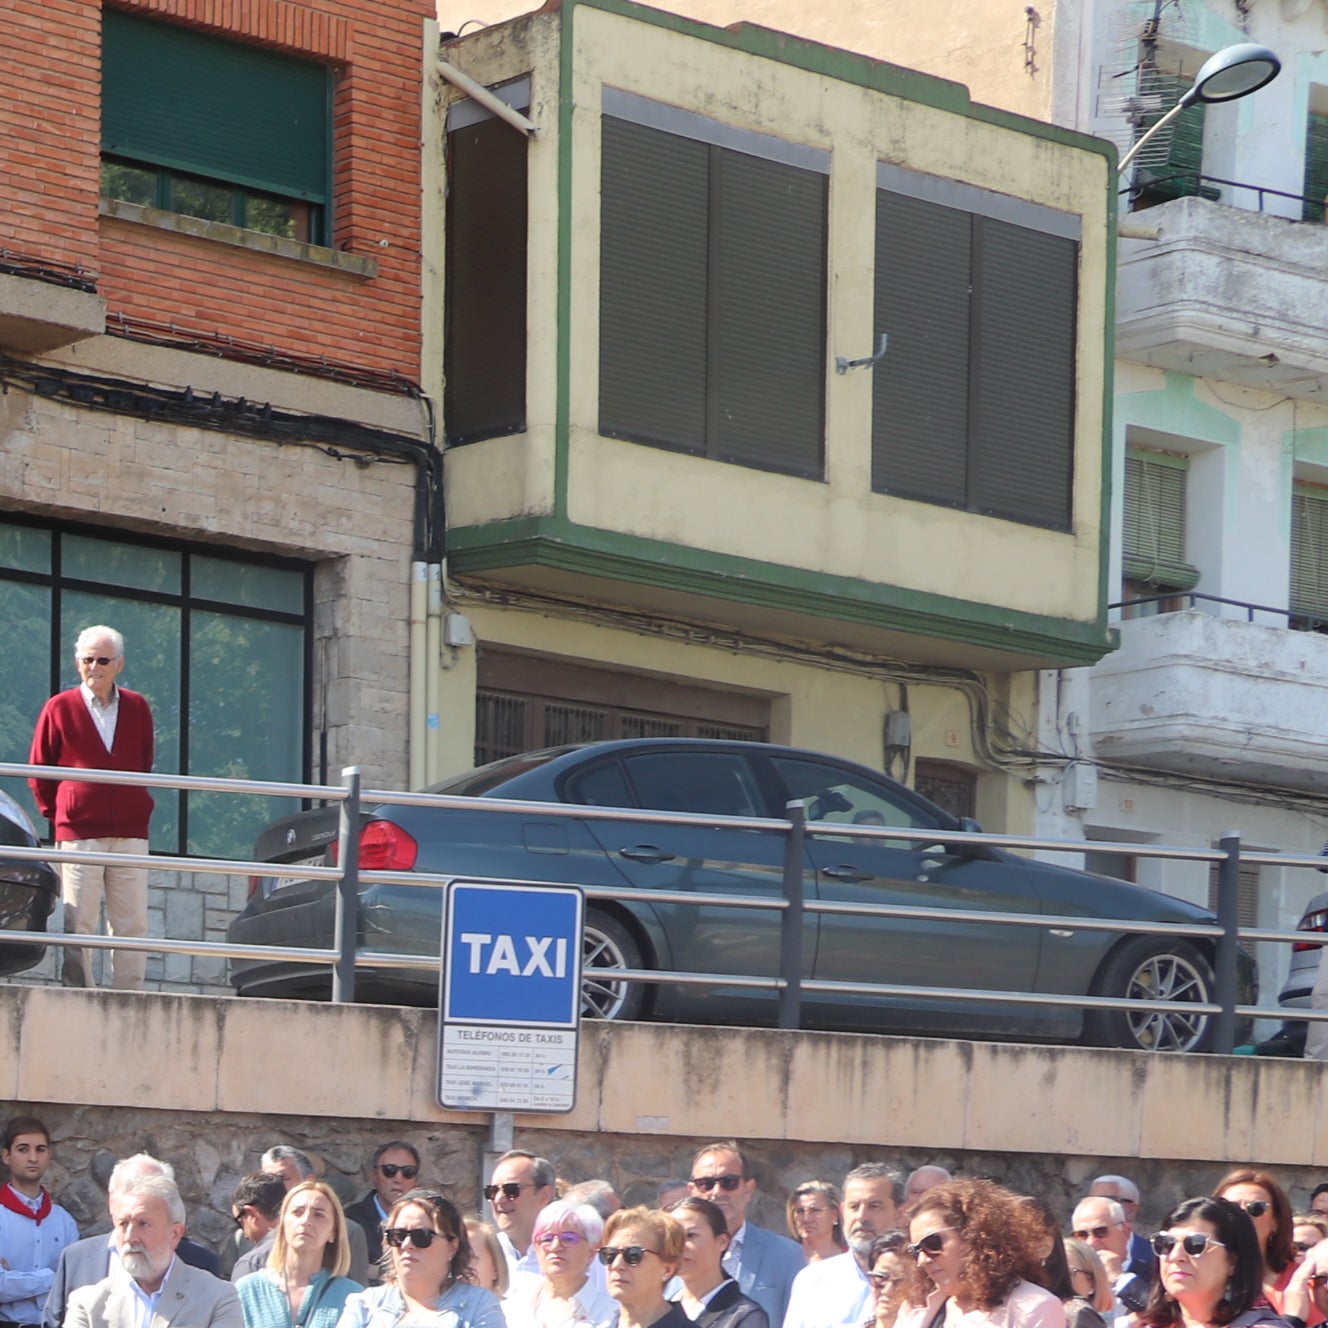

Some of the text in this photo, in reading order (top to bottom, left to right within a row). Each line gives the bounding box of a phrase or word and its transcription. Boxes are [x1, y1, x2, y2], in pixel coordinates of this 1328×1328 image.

[461, 933, 567, 978] TAXI
[457, 1030, 563, 1044] TELÉFONOS DE TAXIS
